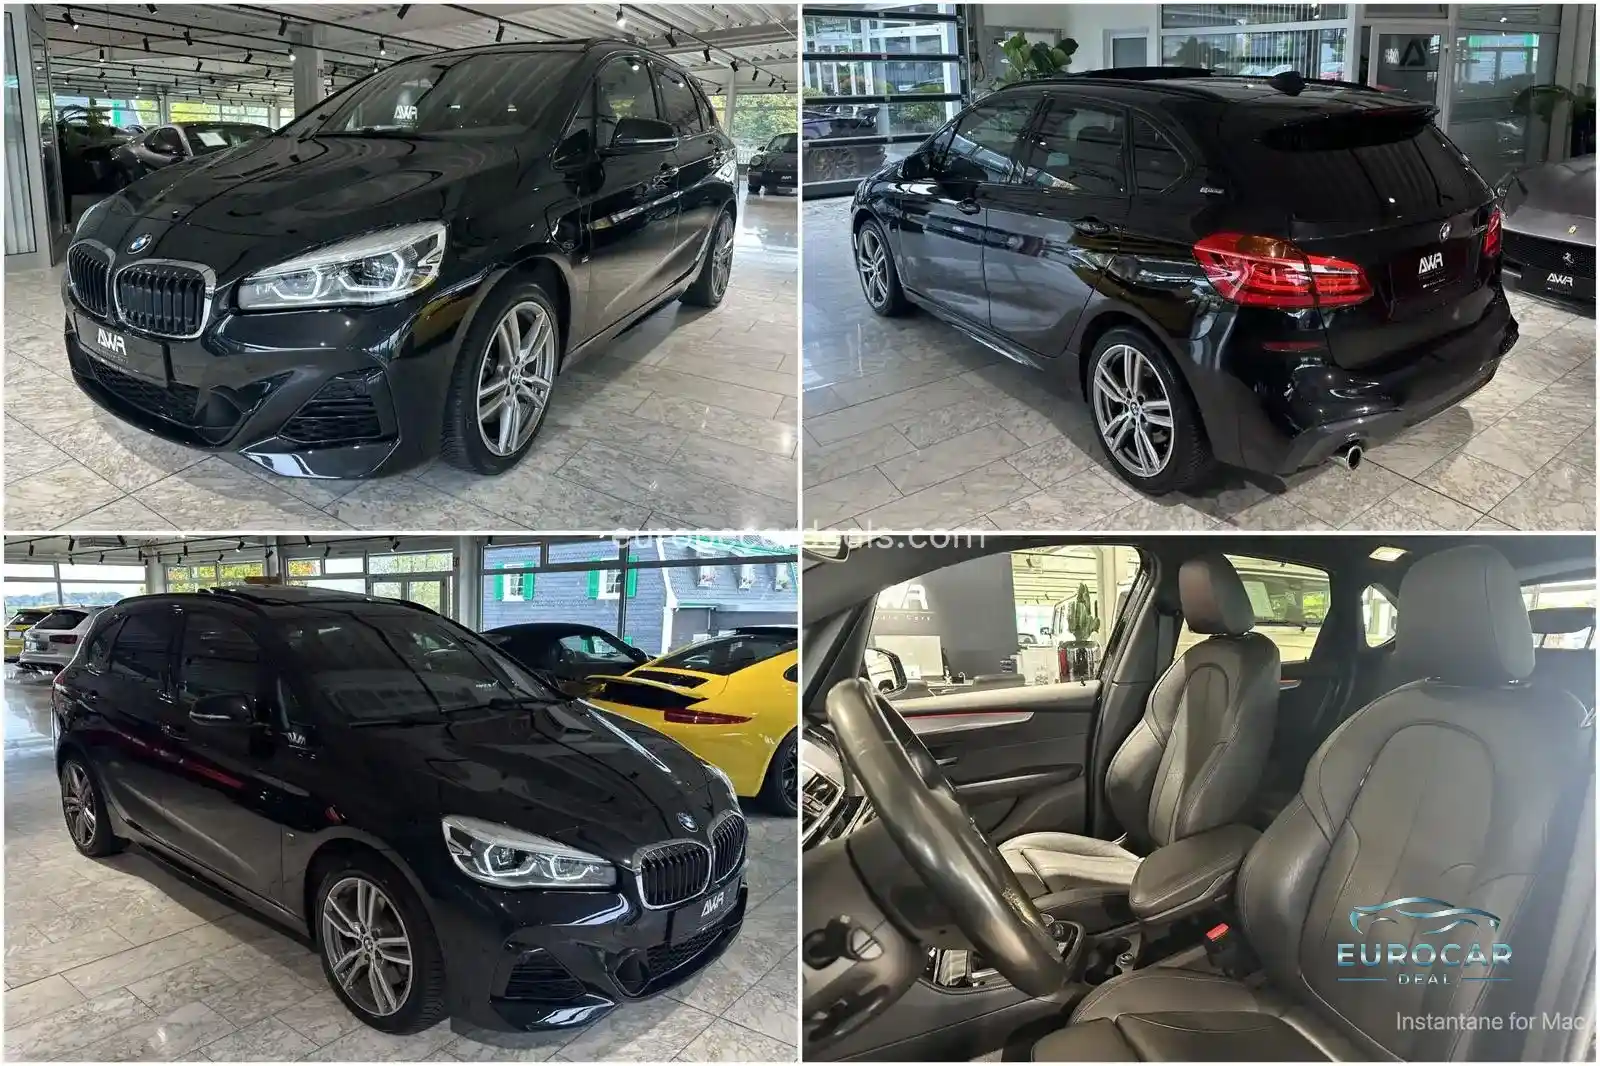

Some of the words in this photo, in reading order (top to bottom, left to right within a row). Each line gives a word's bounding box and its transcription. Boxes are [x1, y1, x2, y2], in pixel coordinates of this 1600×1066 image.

[1418, 252, 1444, 275] AWR
[1546, 272, 1573, 287] AWR
[97, 327, 127, 356] AWR
[701, 891, 725, 917] AWR
